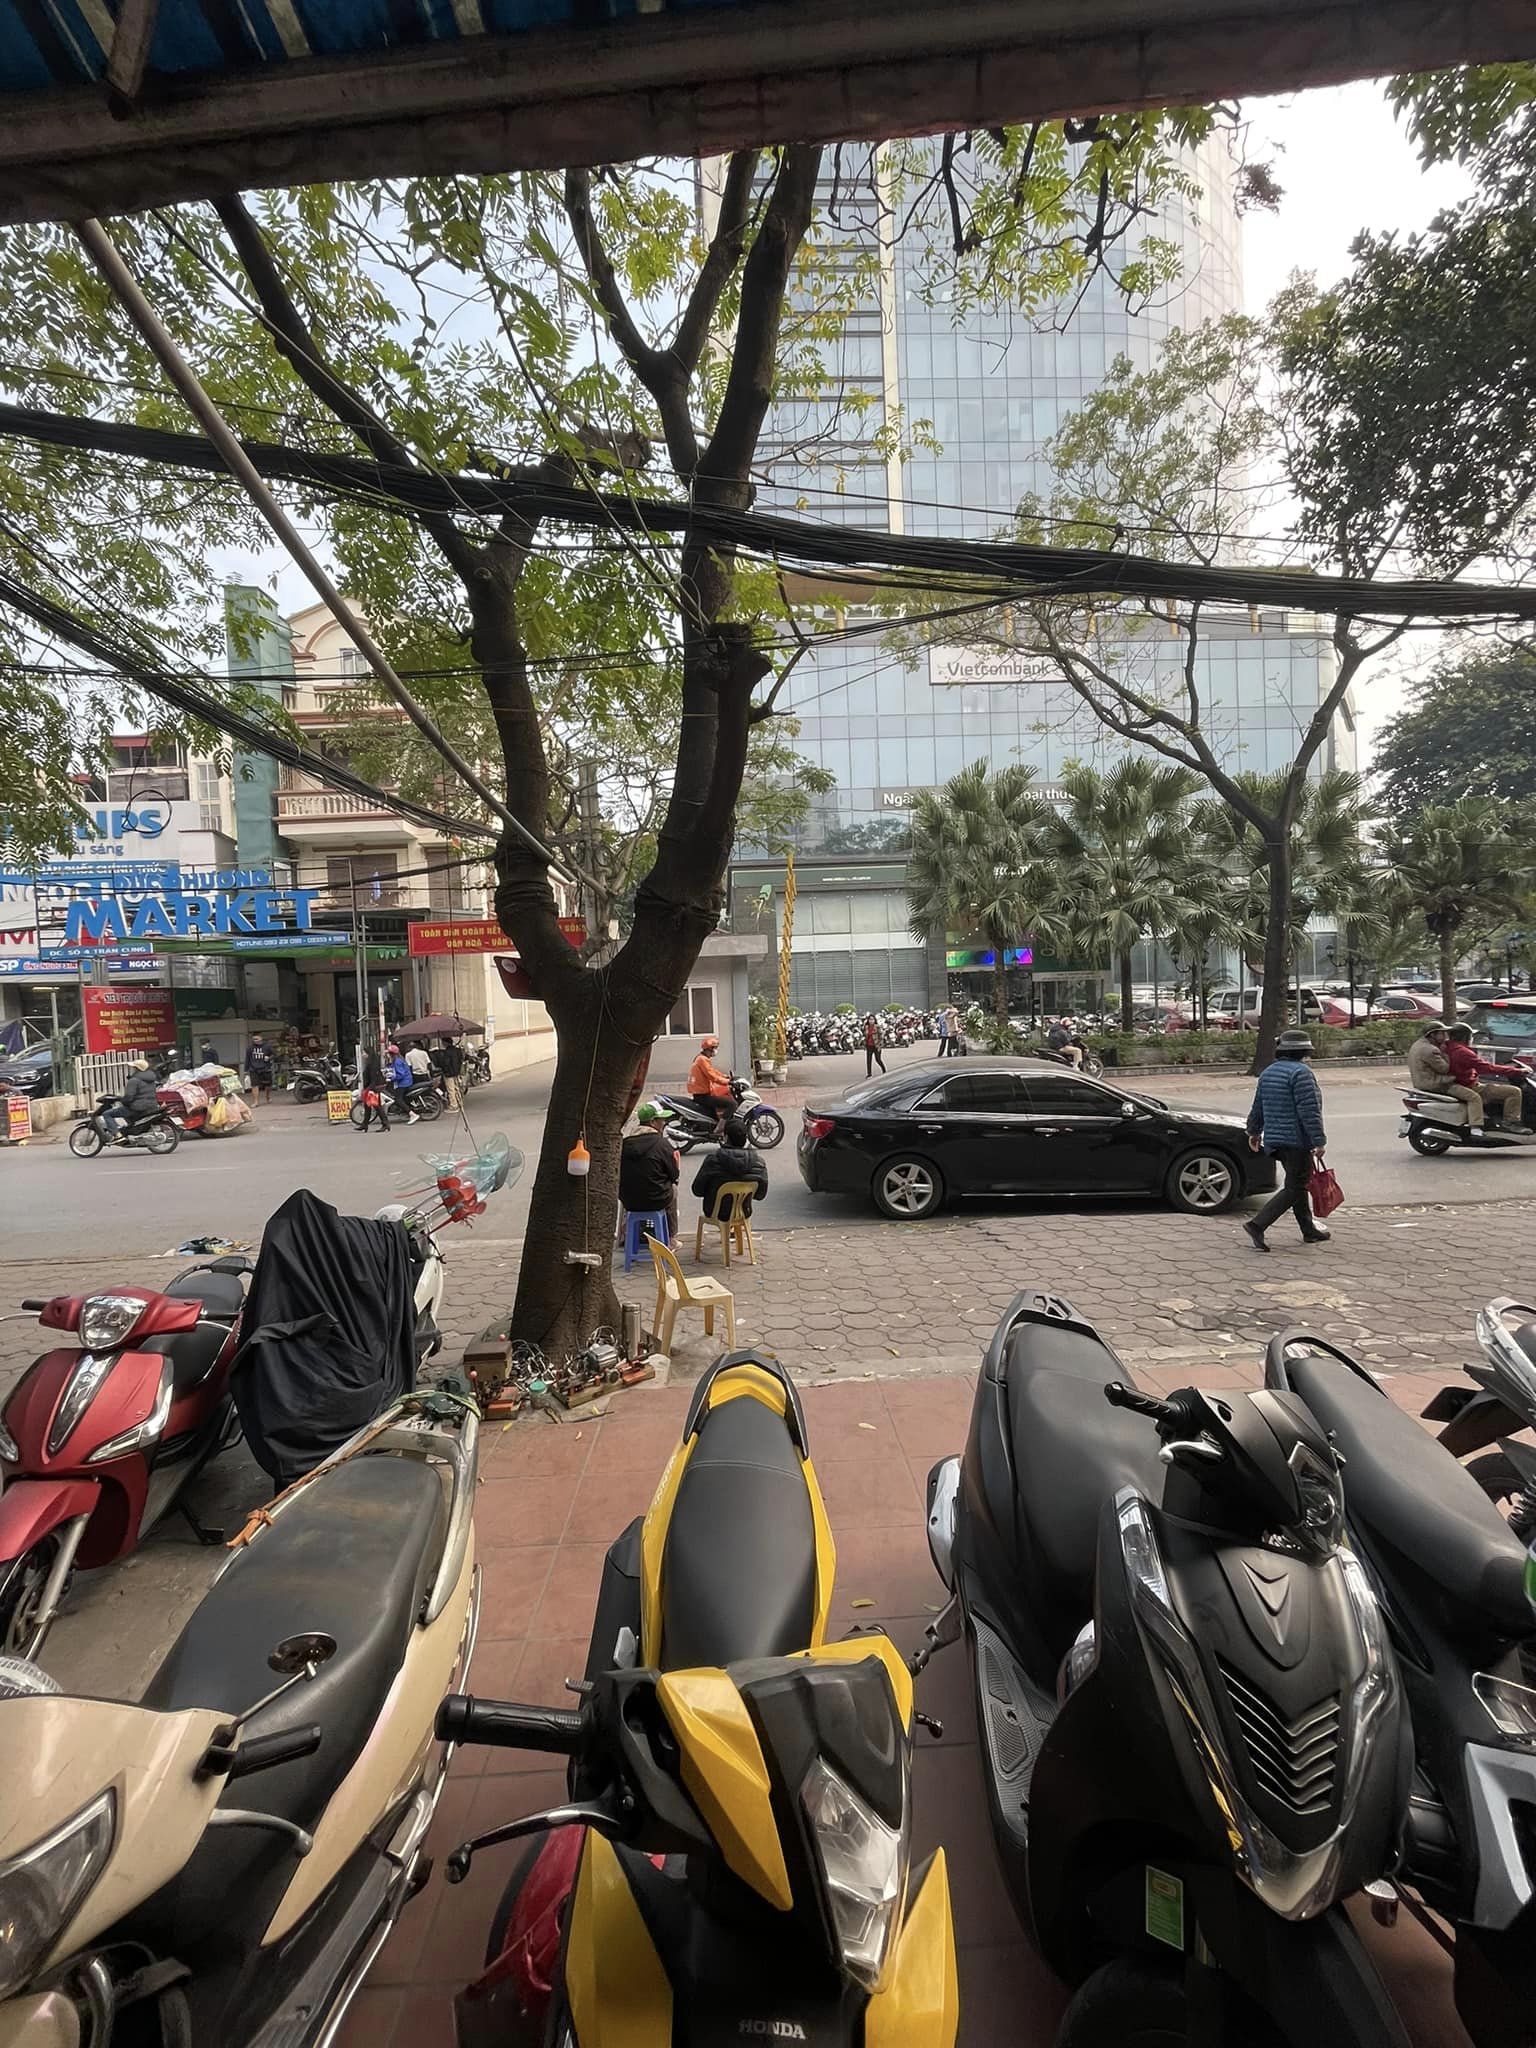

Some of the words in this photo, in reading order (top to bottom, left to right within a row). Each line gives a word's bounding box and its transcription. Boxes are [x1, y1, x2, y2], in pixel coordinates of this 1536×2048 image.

[947, 660, 1049, 677] Vietcombank
[90, 843, 124, 856] sáng
[64, 889, 319, 941] MARKET
[738, 2019, 806, 2040] HONDA
